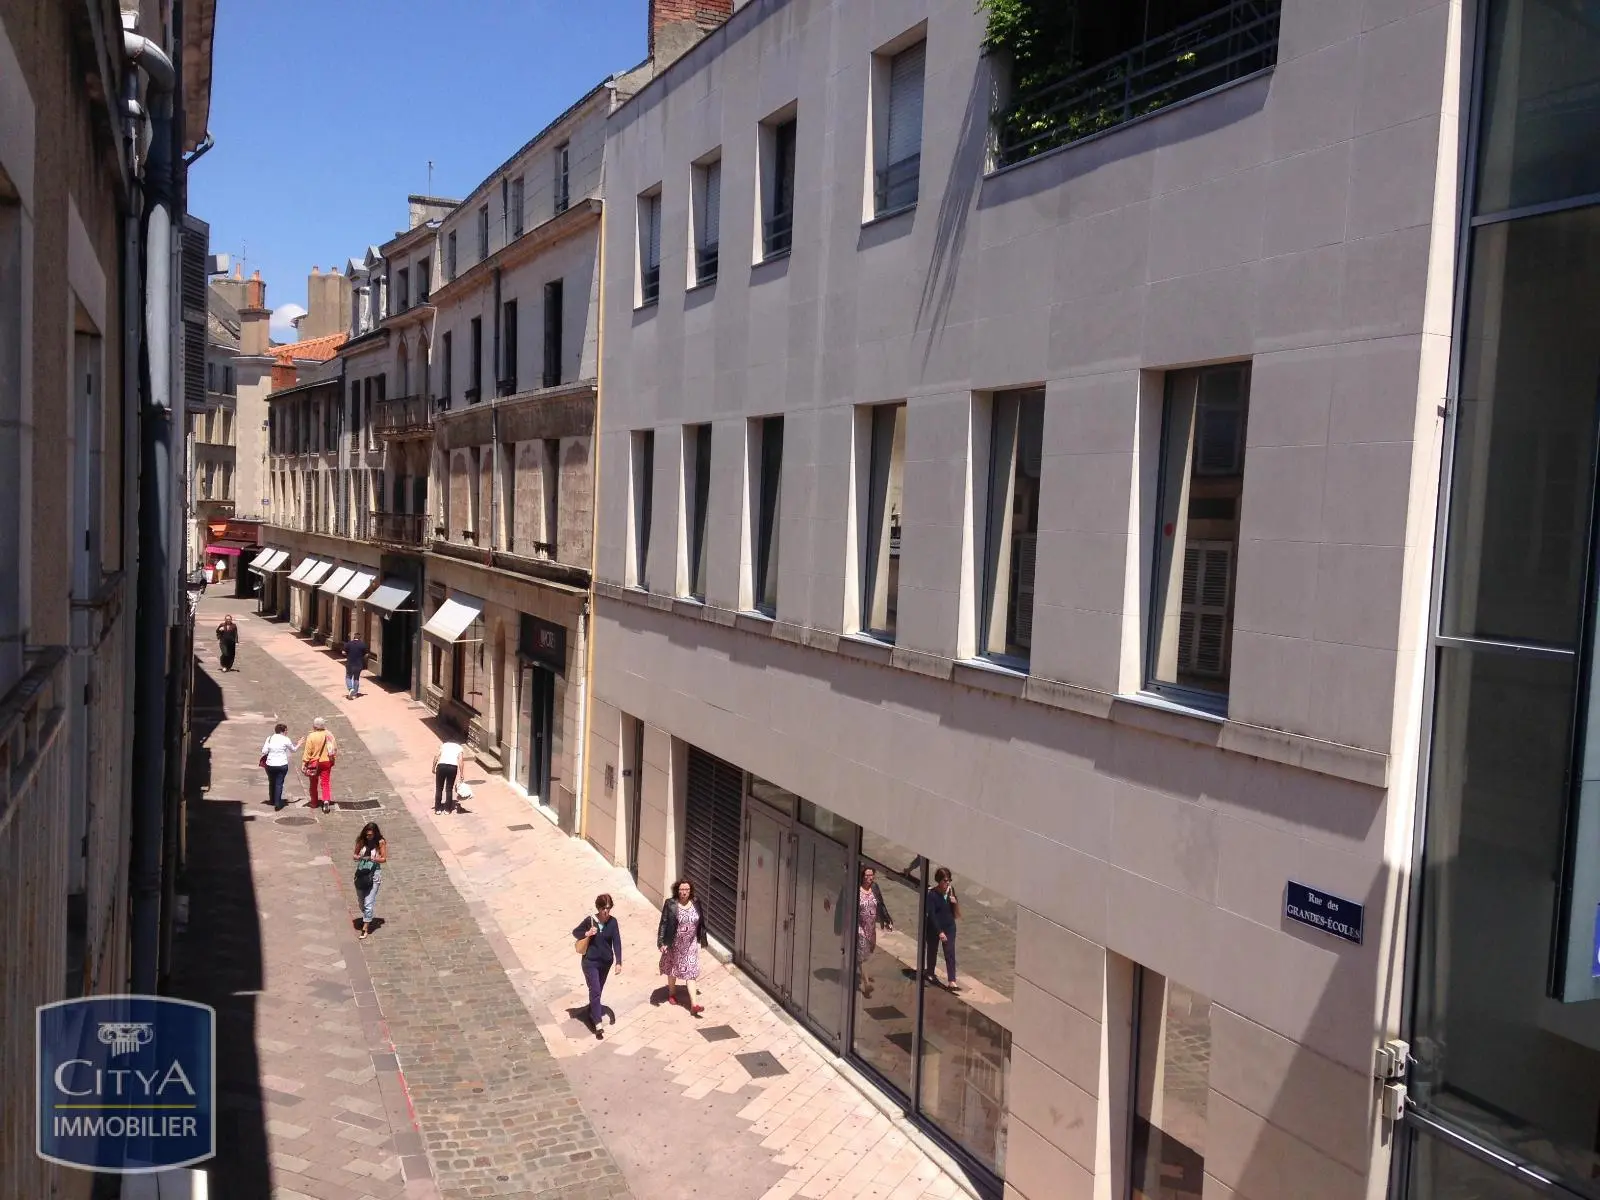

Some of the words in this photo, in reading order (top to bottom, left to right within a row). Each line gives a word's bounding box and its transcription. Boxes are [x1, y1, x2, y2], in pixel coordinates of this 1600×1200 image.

[1308, 893, 1323, 906] Rue
[1327, 899, 1339, 911] des
[1287, 904, 1361, 938] GRANDES-ÉCOLES
